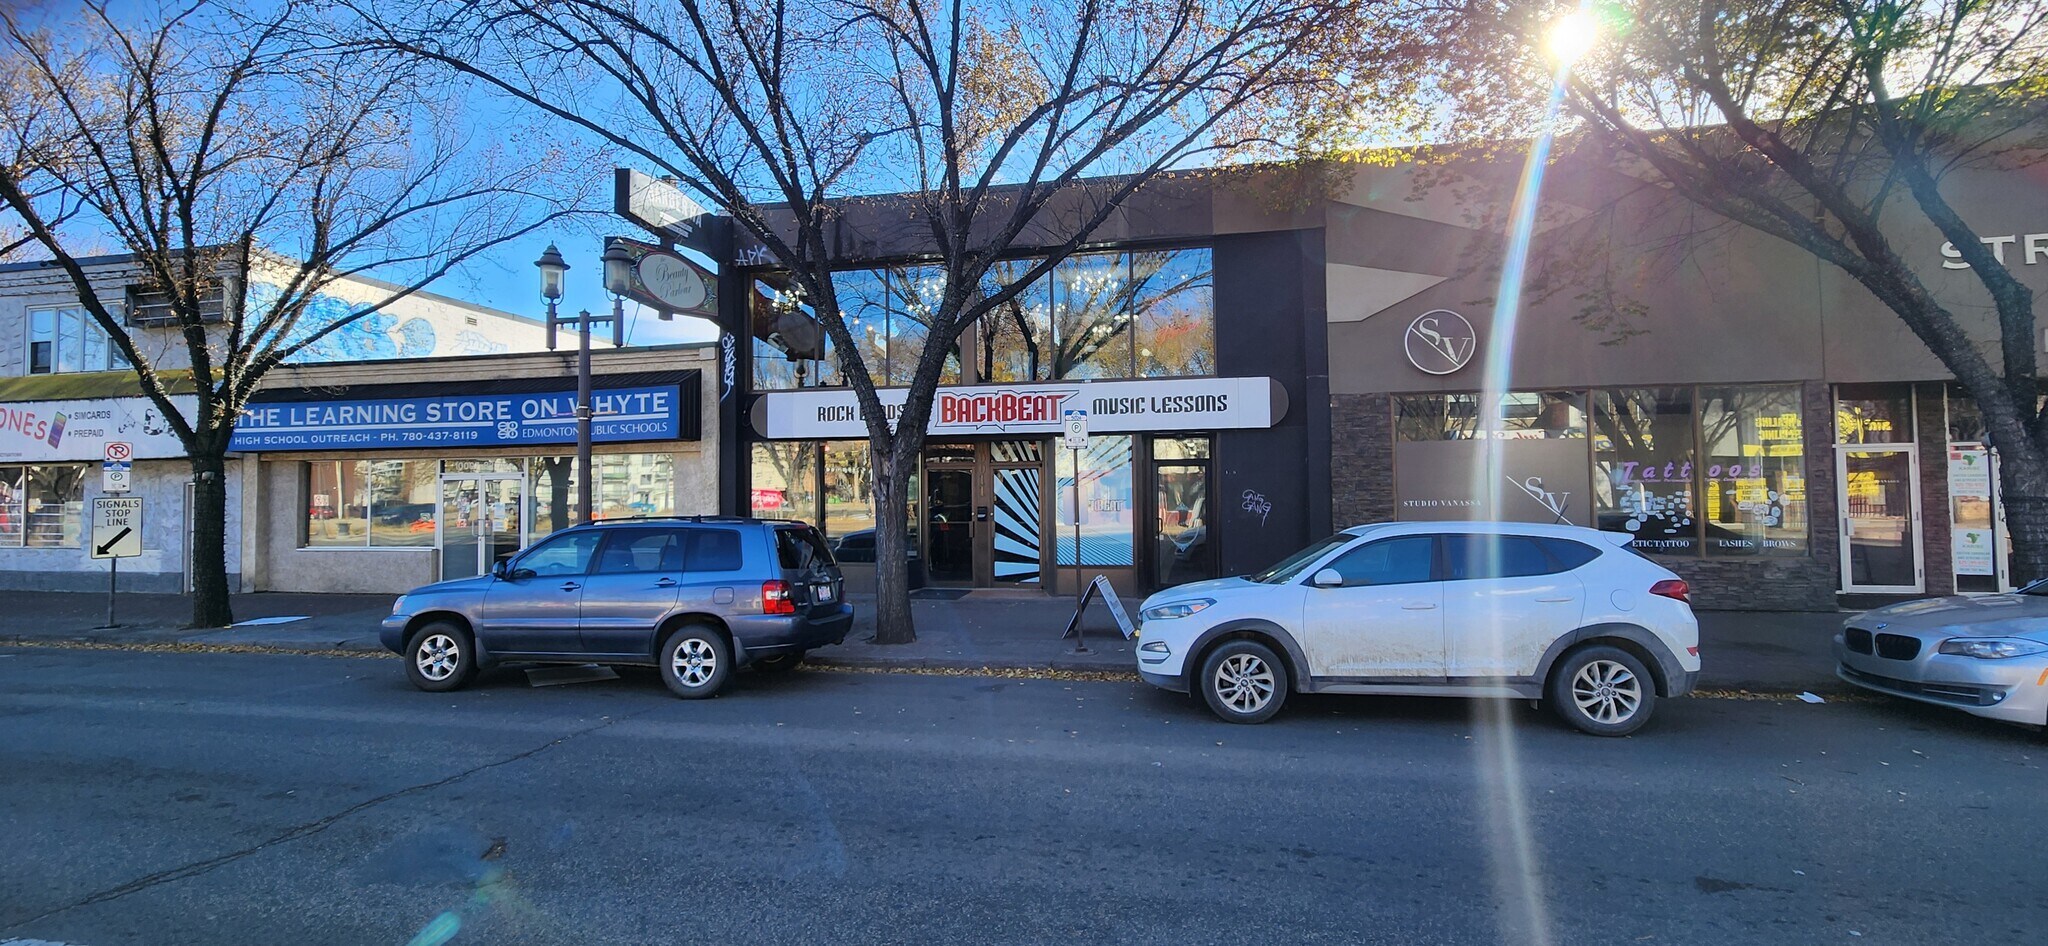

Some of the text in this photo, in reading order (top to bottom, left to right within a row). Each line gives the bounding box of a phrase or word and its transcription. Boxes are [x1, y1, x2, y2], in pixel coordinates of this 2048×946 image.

[656, 264, 689, 282] Beauty
[1419, 318, 1472, 362] SV
[941, 393, 1070, 423] BACKBEAT
[1092, 394, 1228, 415] MUSIC LESSONS
[74, 410, 111, 420] SIMCARDS
[290, 403, 416, 426] LEARNING
[426, 400, 511, 422] STORE
[521, 398, 558, 418] ON
[817, 405, 854, 422] ROCK
[74, 429, 104, 438] PREPAID
[591, 424, 617, 435] UBLIC
[619, 422, 668, 434] SCHOOLS
[234, 436, 260, 445] HIGH
[264, 435, 307, 445] SCHOOL
[311, 433, 370, 443] OUTREACH
[380, 433, 399, 441] PH.
[402, 431, 478, 441] 780-437-8119
[96, 500, 140, 509] SIGNALS
[105, 509, 131, 518] STOP
[106, 518, 129, 527] LINE
[1632, 540, 1690, 548] ETIC TATTOO
[1719, 540, 1797, 548] LASHES BROWS
